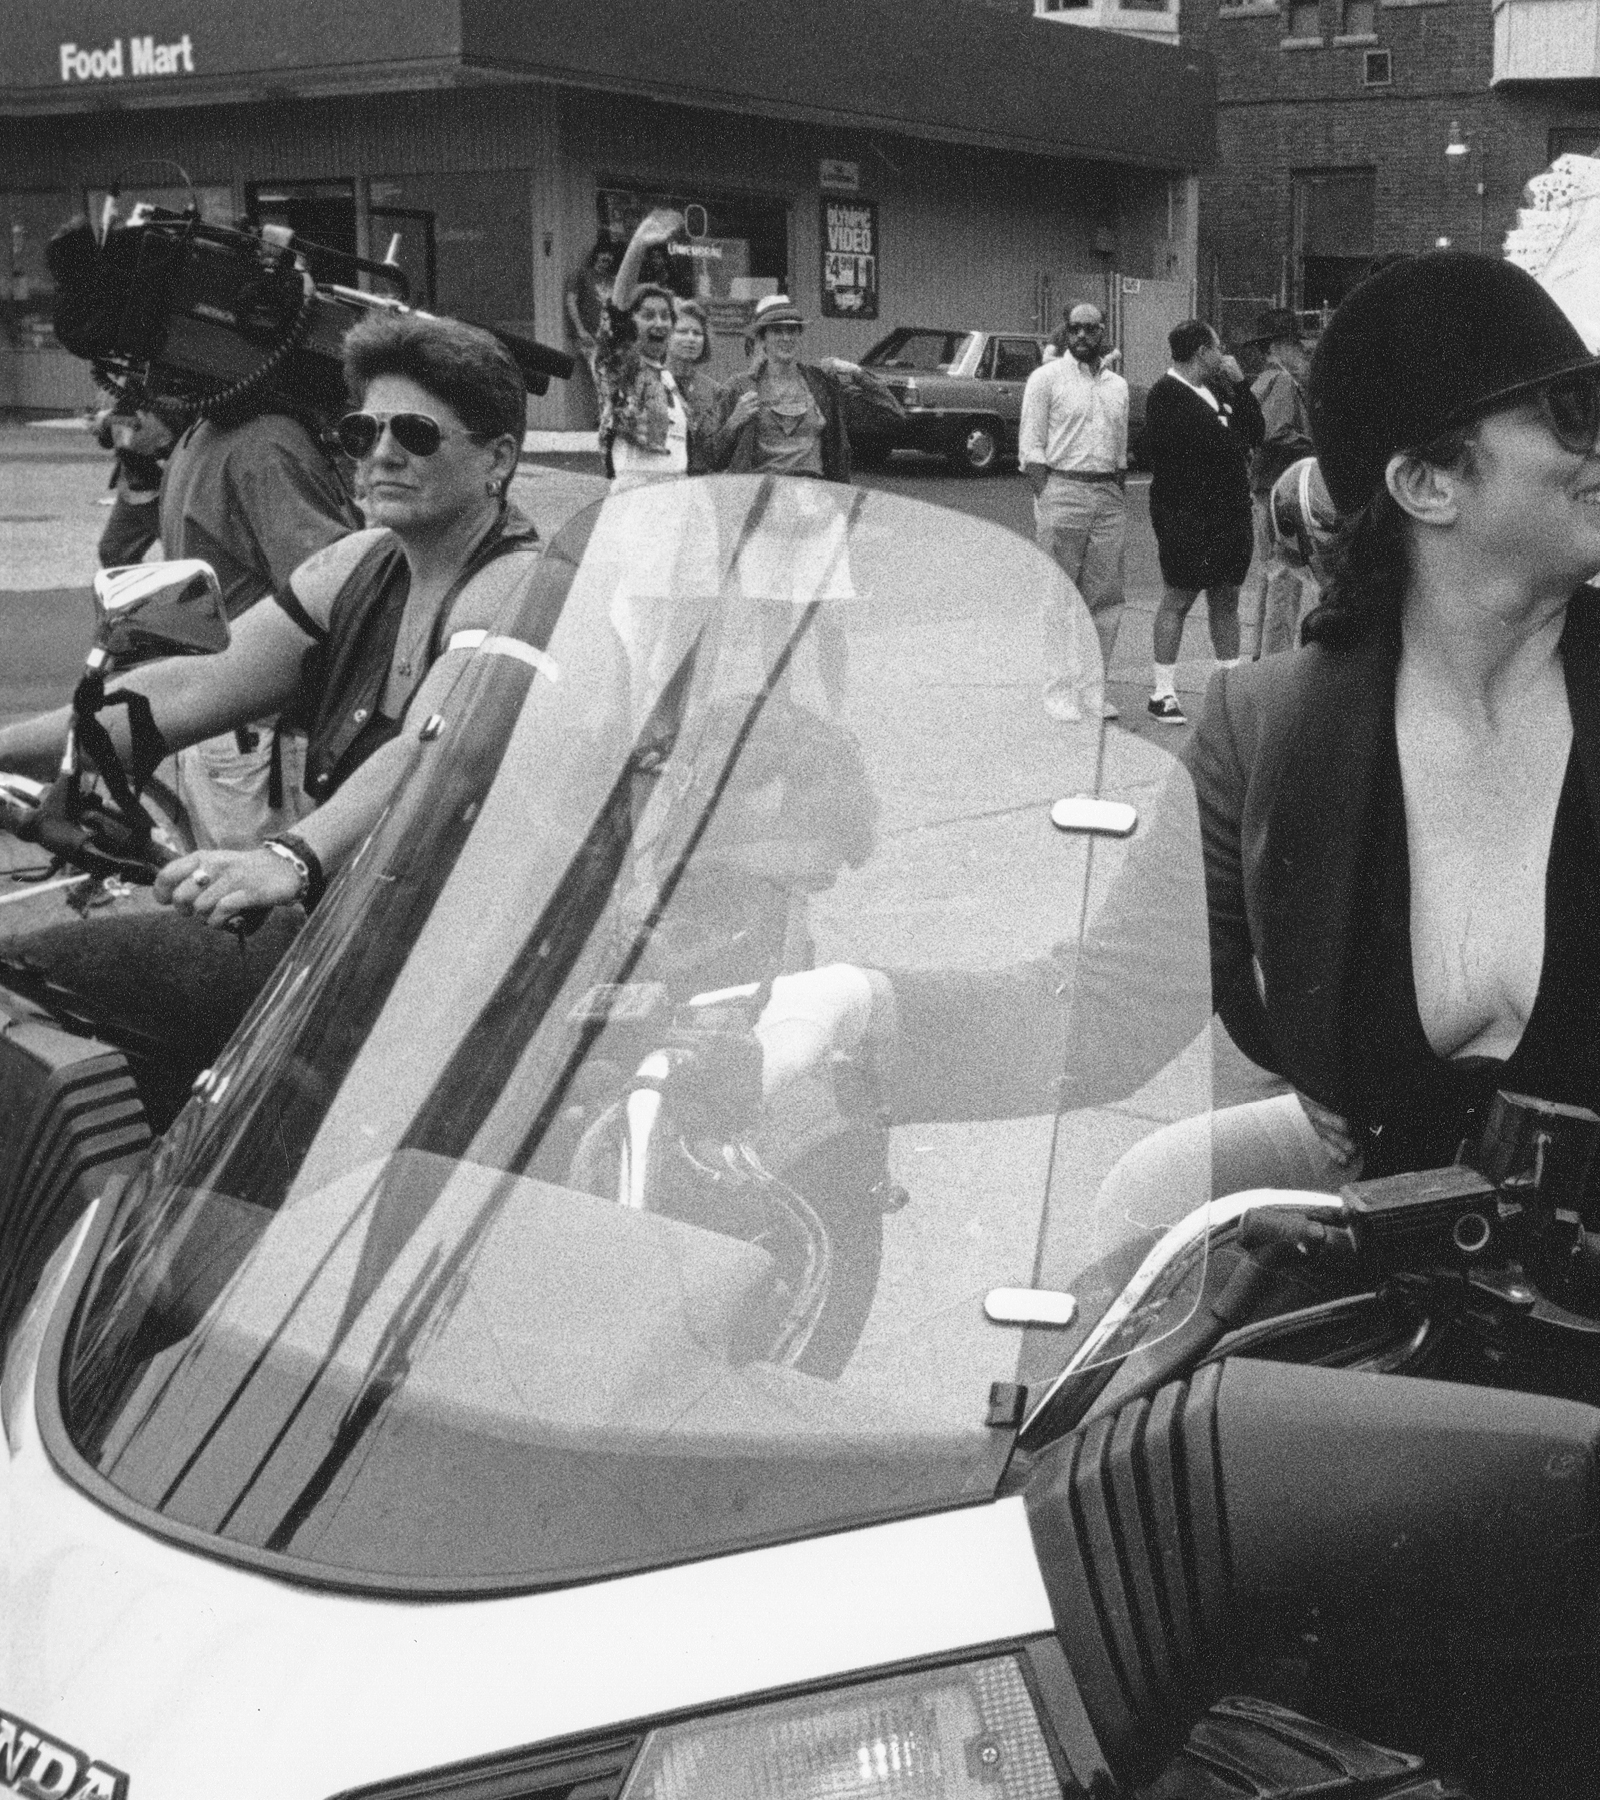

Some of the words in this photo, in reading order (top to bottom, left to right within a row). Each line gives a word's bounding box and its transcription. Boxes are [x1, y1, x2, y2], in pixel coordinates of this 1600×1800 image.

[60, 38, 124, 81] Food
[130, 34, 195, 76] Mart
[828, 226, 871, 253] VIDEO
